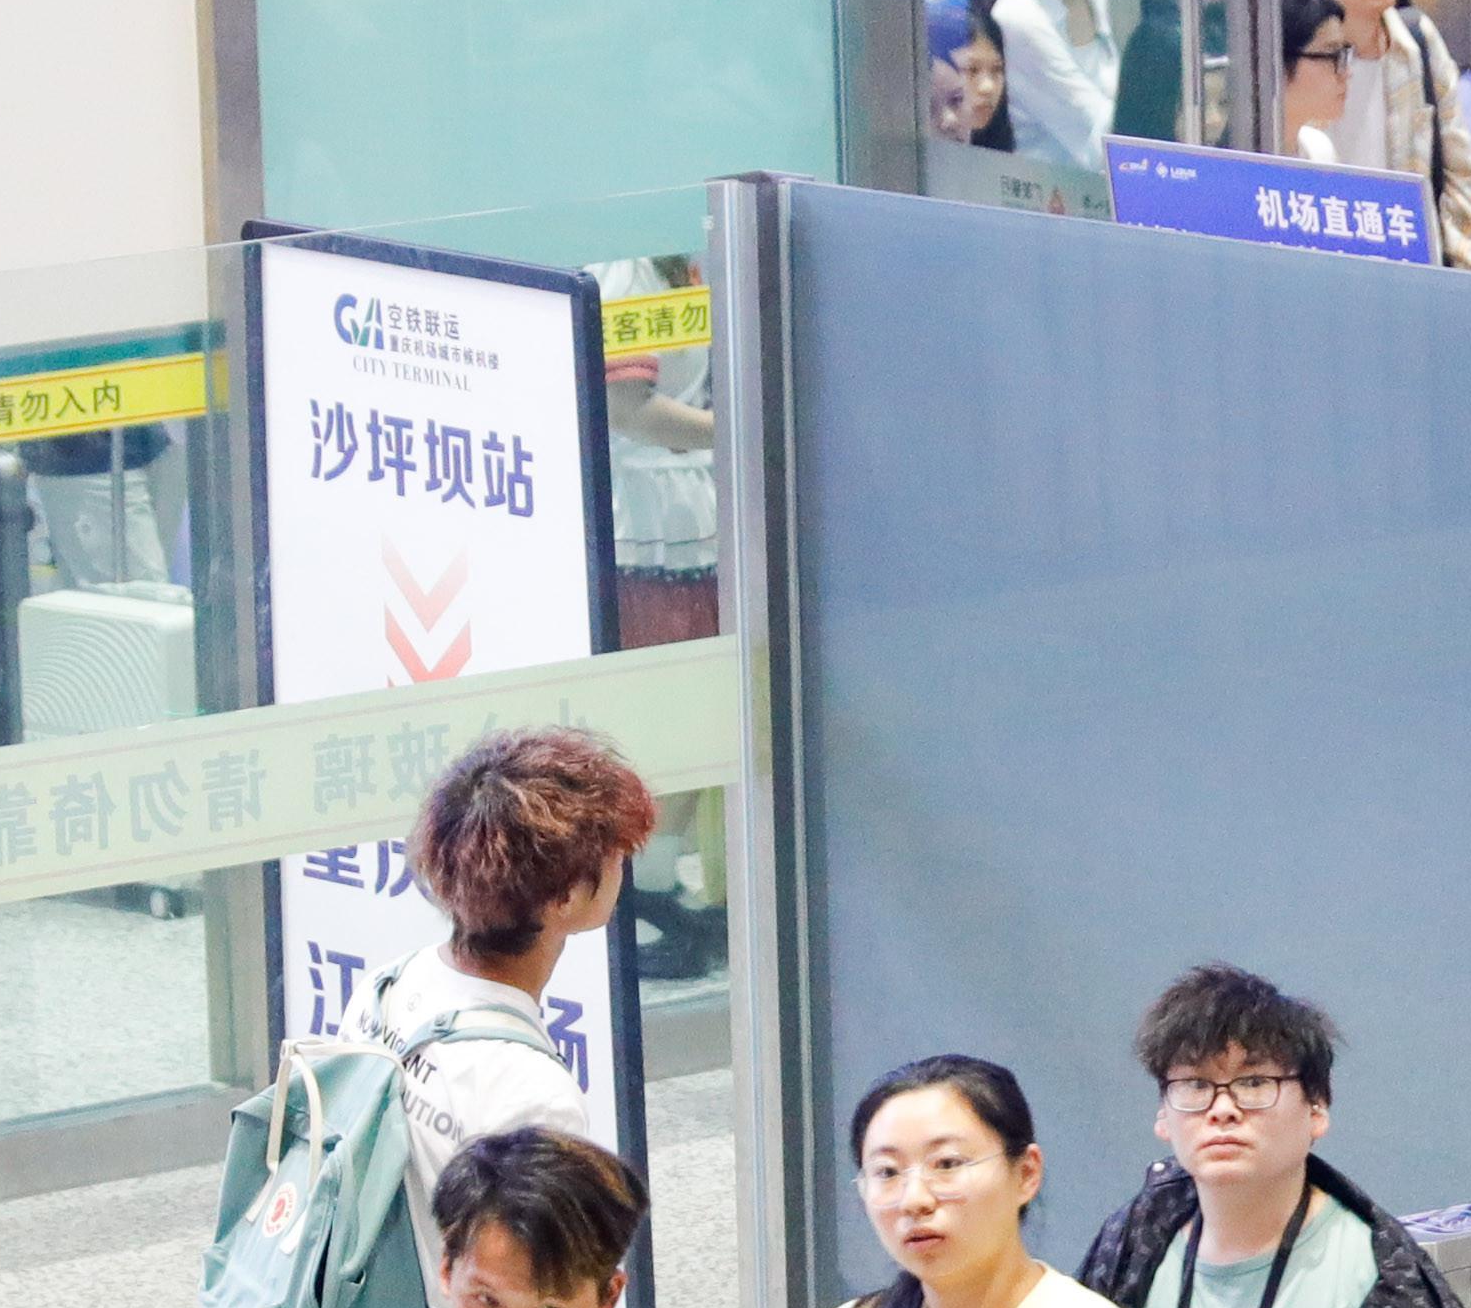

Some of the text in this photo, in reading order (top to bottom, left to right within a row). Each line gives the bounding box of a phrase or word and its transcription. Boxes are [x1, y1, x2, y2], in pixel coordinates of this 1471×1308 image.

[1255, 186, 1418, 246] 机场直通车
[386, 303, 461, 342] 空铁联运
[352, 355, 473, 393] CITY TERMINAL
[309, 398, 535, 519] 沙坪坝站
